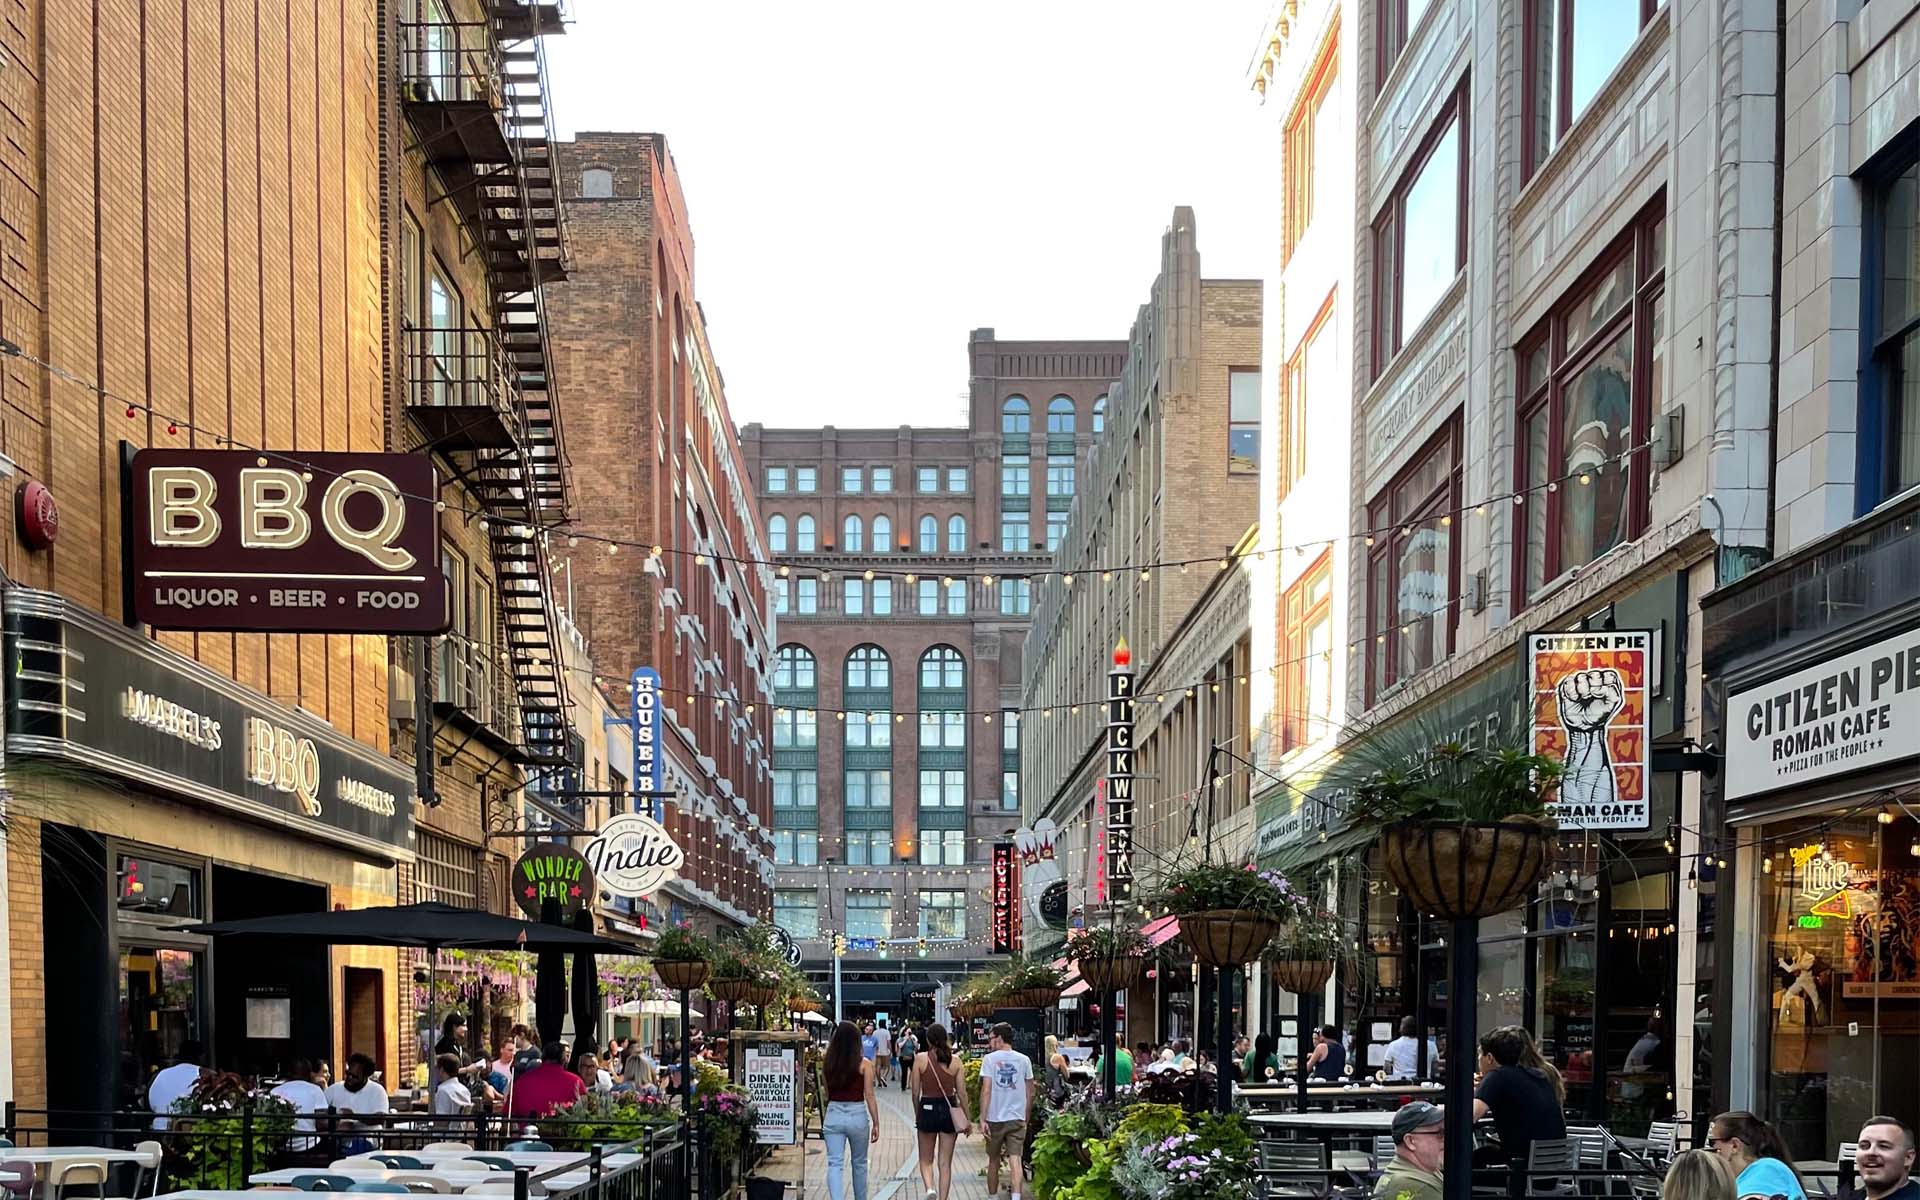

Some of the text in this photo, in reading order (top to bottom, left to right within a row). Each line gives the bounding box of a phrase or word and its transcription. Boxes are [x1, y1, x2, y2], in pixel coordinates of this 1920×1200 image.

[149, 467, 417, 571] BBQ
[155, 588, 420, 609] LIQUOR BEER FOOD
[1536, 636, 1645, 650] CITIZEN PIE
[1747, 645, 1920, 741] CITIZEN PIE
[636, 677, 654, 761] HOUSE
[1772, 703, 1891, 762] ROMAN CAFE
[127, 686, 221, 750] MABEL'S
[245, 716, 321, 817] BBQ
[640, 763, 653, 773] of
[1789, 740, 1868, 774] PIZZA FOR THE PEOPLE
[1115, 675, 1130, 874] PICKWICK
[1545, 804, 1645, 817] OMAN CAFE
[1603, 816, 1628, 824] PEOPLE
[521, 856, 584, 882] WONDER
[585, 835, 678, 876] Indie
[1801, 858, 1849, 900] Lite
[749, 1059, 791, 1072] OPEN
[749, 1074, 791, 1083] DINE IN
